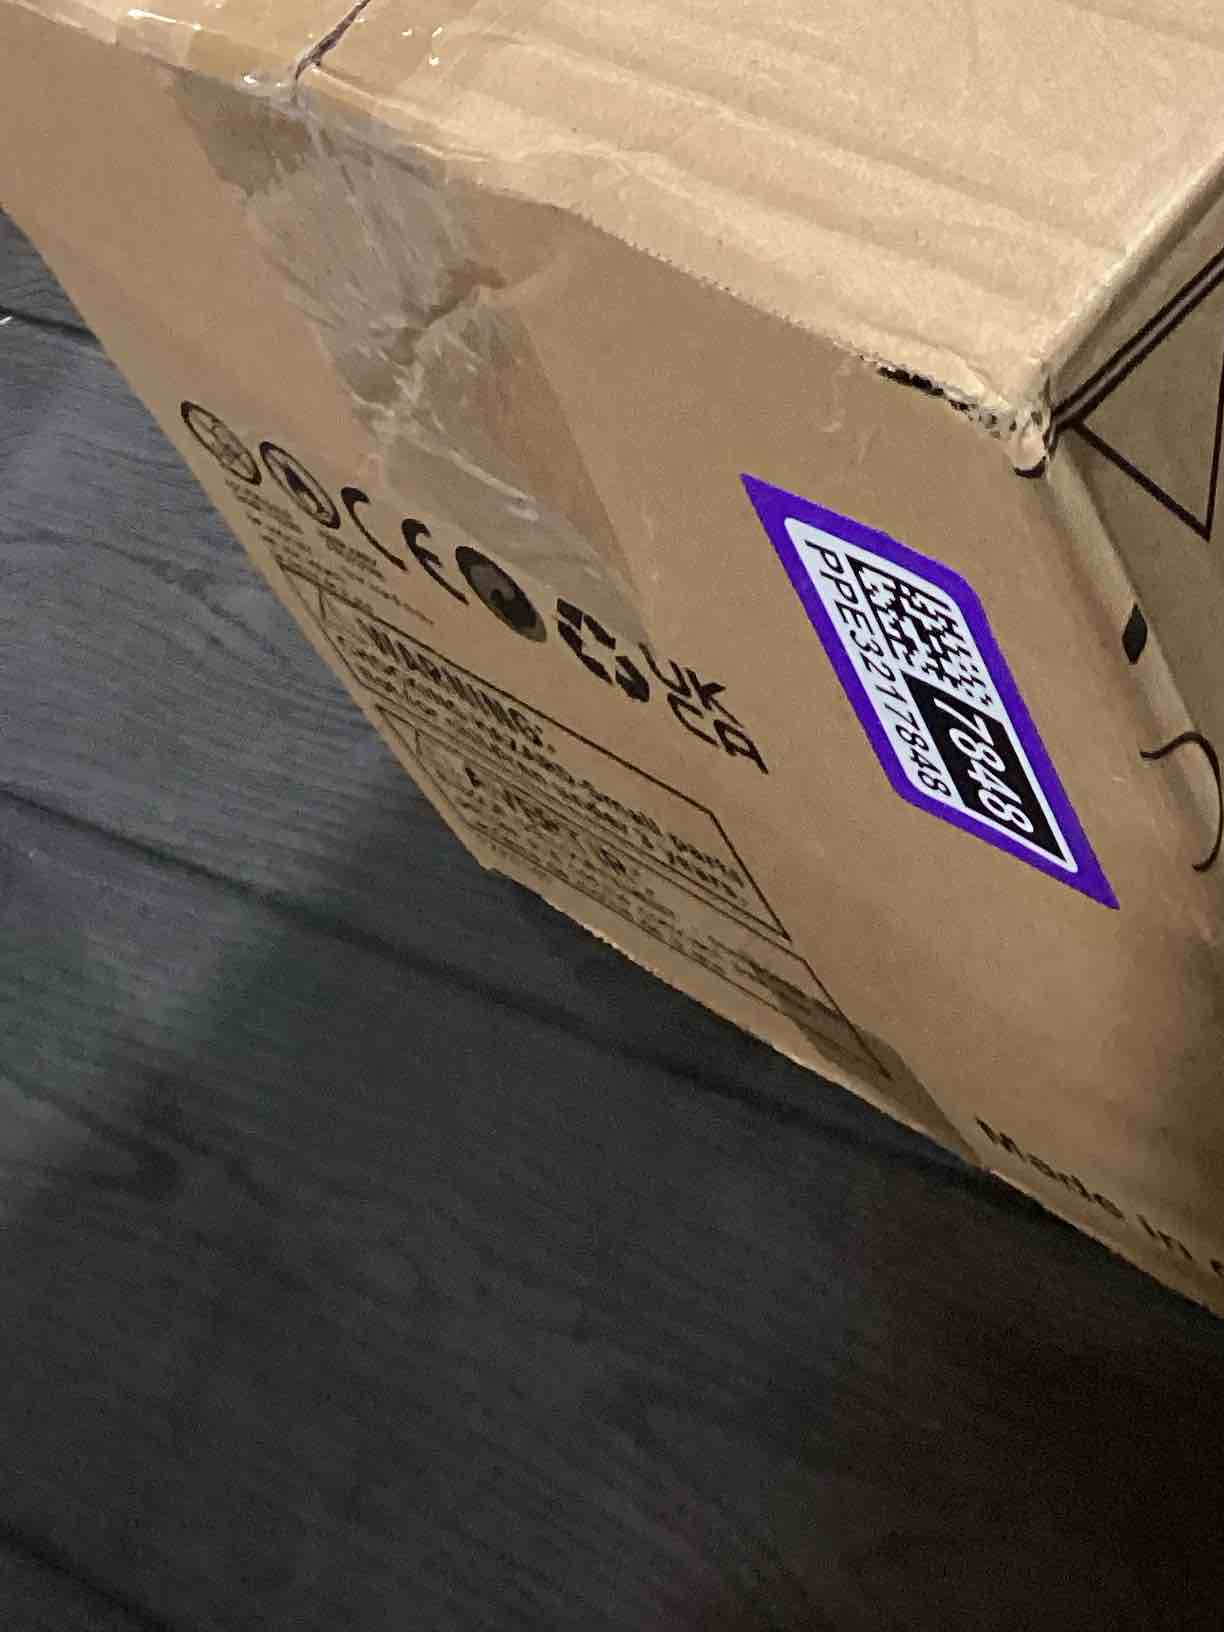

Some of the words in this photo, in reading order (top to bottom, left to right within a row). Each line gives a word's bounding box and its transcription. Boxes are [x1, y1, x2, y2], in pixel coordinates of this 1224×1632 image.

[639, 641, 745, 729] UK
[804, 539, 953, 798] PPE3217848
[666, 692, 769, 776] CA
[933, 695, 1035, 833] 7848
[974, 1116, 1125, 1222] Made
